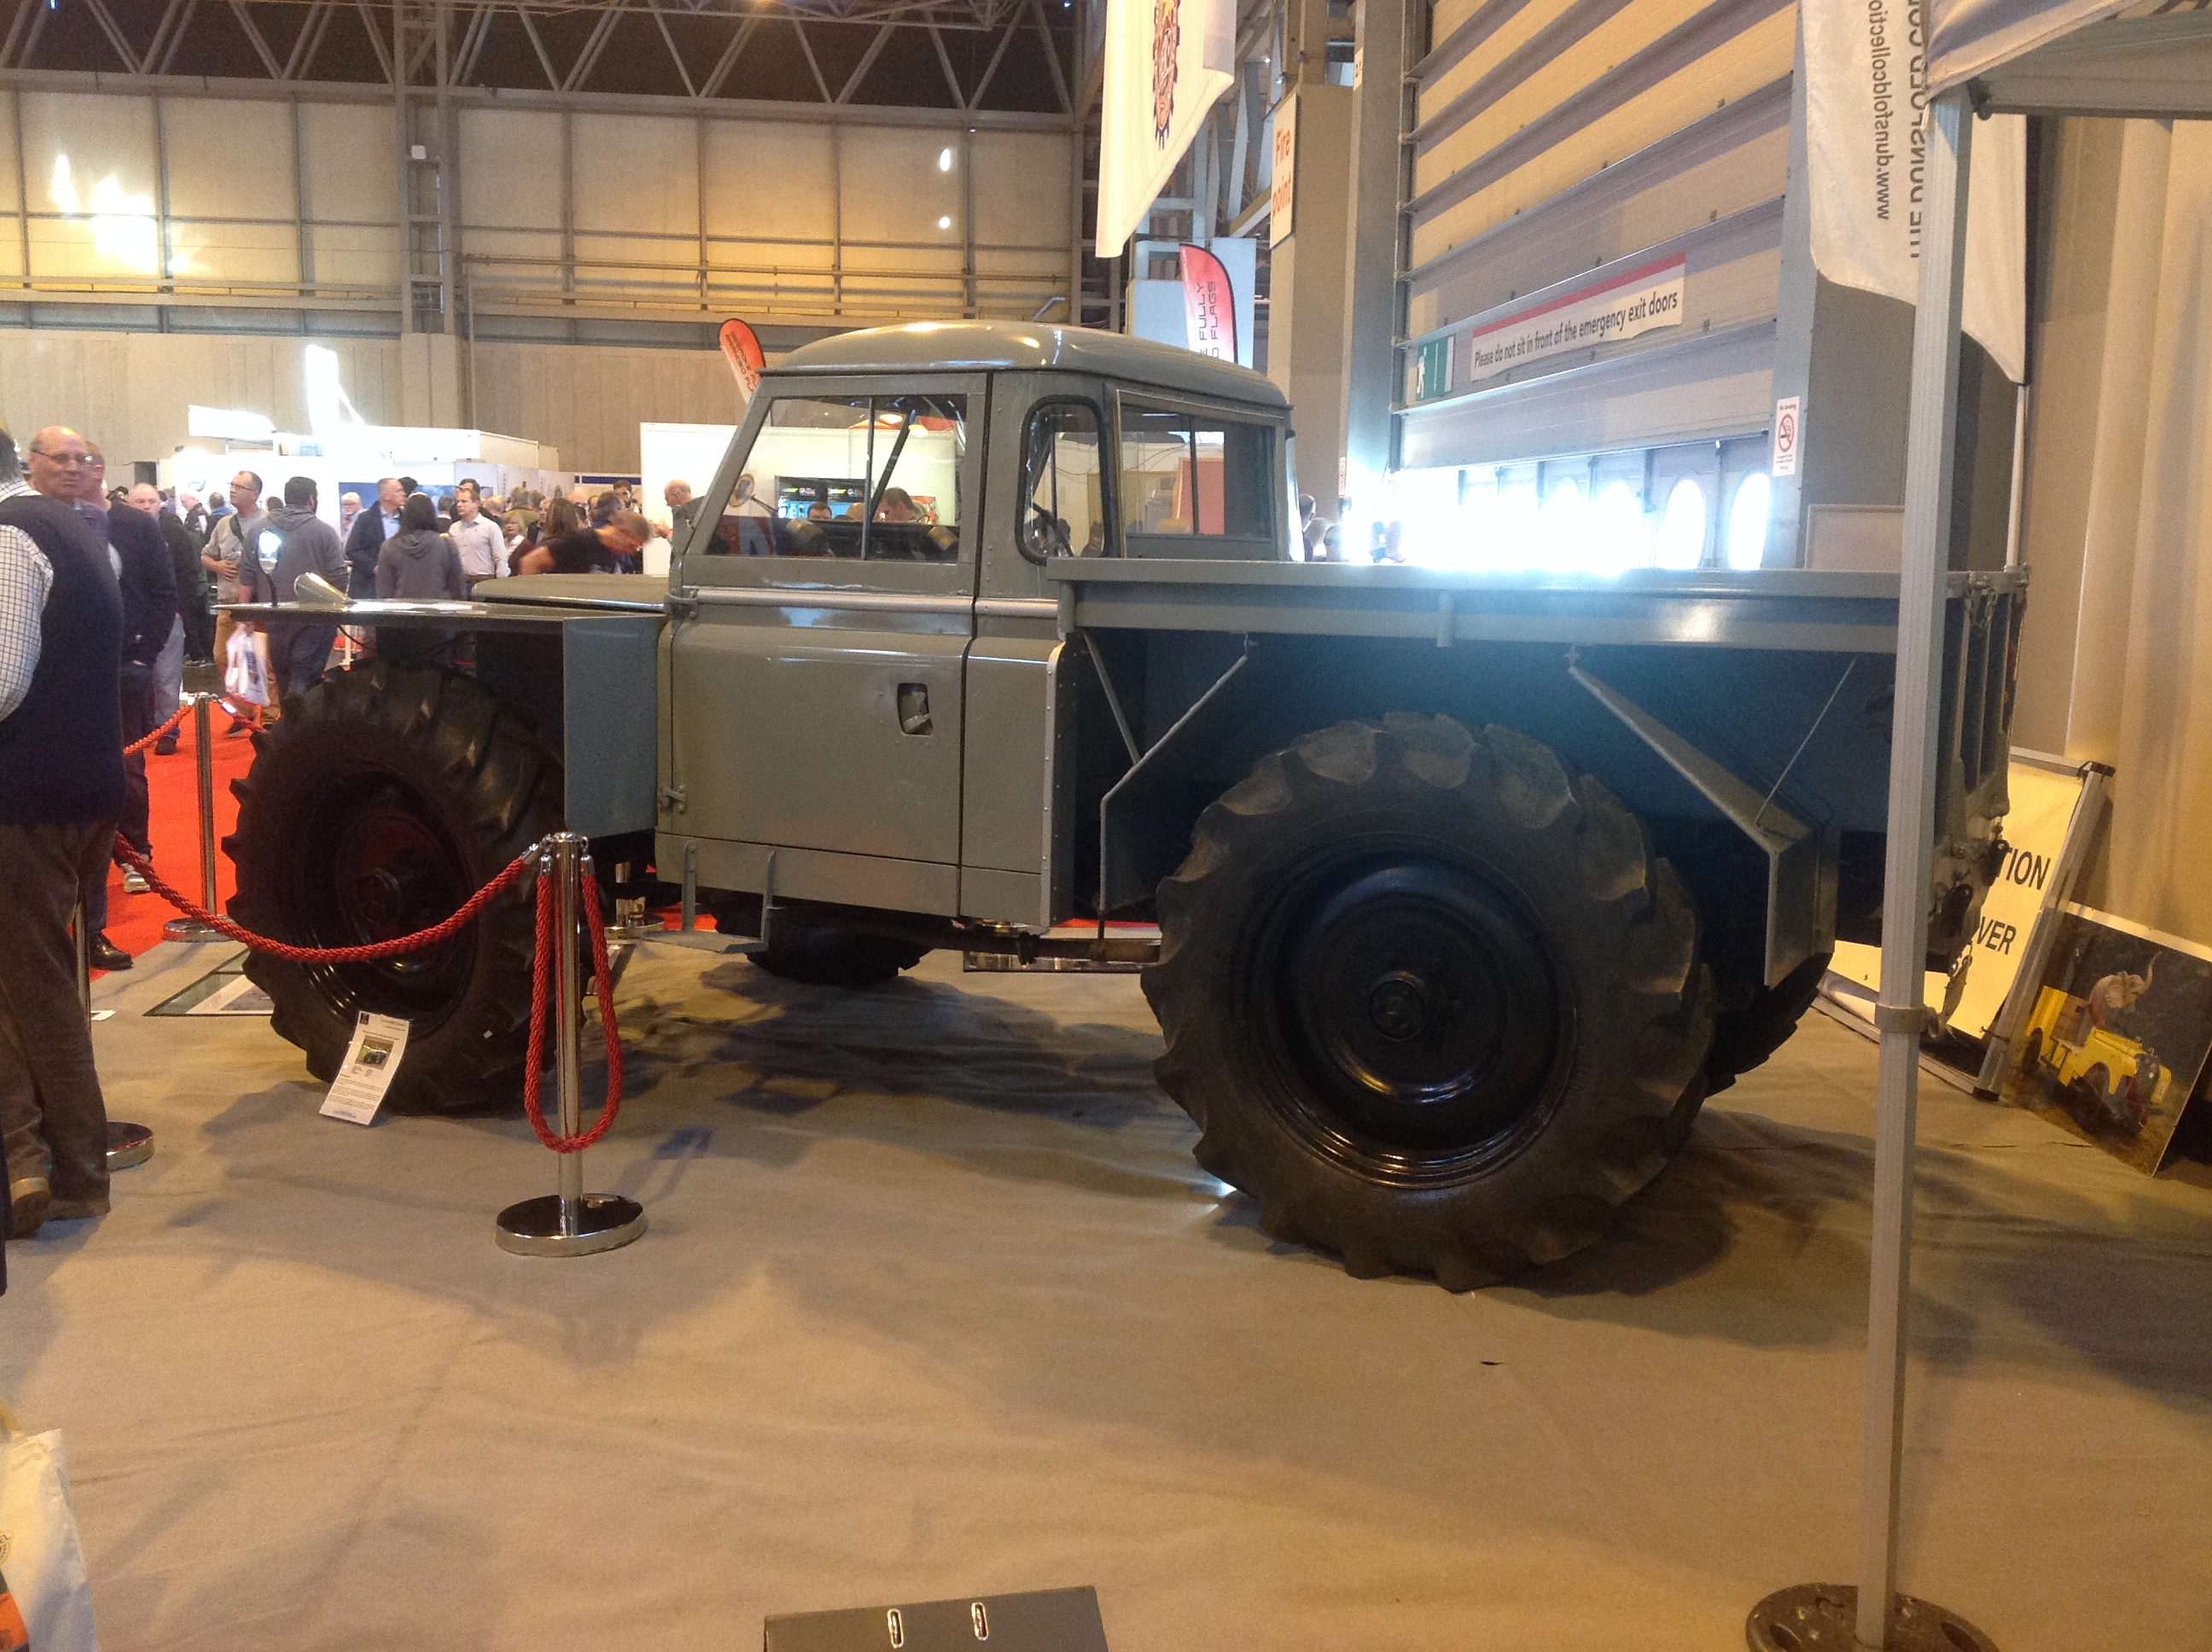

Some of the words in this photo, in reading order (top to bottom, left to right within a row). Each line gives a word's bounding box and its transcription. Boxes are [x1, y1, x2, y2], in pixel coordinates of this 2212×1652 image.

[1275, 127, 1290, 166] Fire
[1271, 171, 1291, 224] point
[1196, 282, 1208, 340] FULLY
[1207, 281, 1219, 340] FLAGS
[1474, 346, 1493, 369] Please
[1494, 343, 1504, 363] do
[1504, 341, 1516, 360] not
[1516, 337, 1525, 355] sit
[1526, 335, 1534, 353] in
[1534, 330, 1553, 352] front
[1554, 323, 1564, 344] of
[1564, 323, 1577, 342] the
[1579, 307, 1626, 338] emergency
[1628, 299, 1646, 322] exit
[1649, 291, 1678, 316] doors
